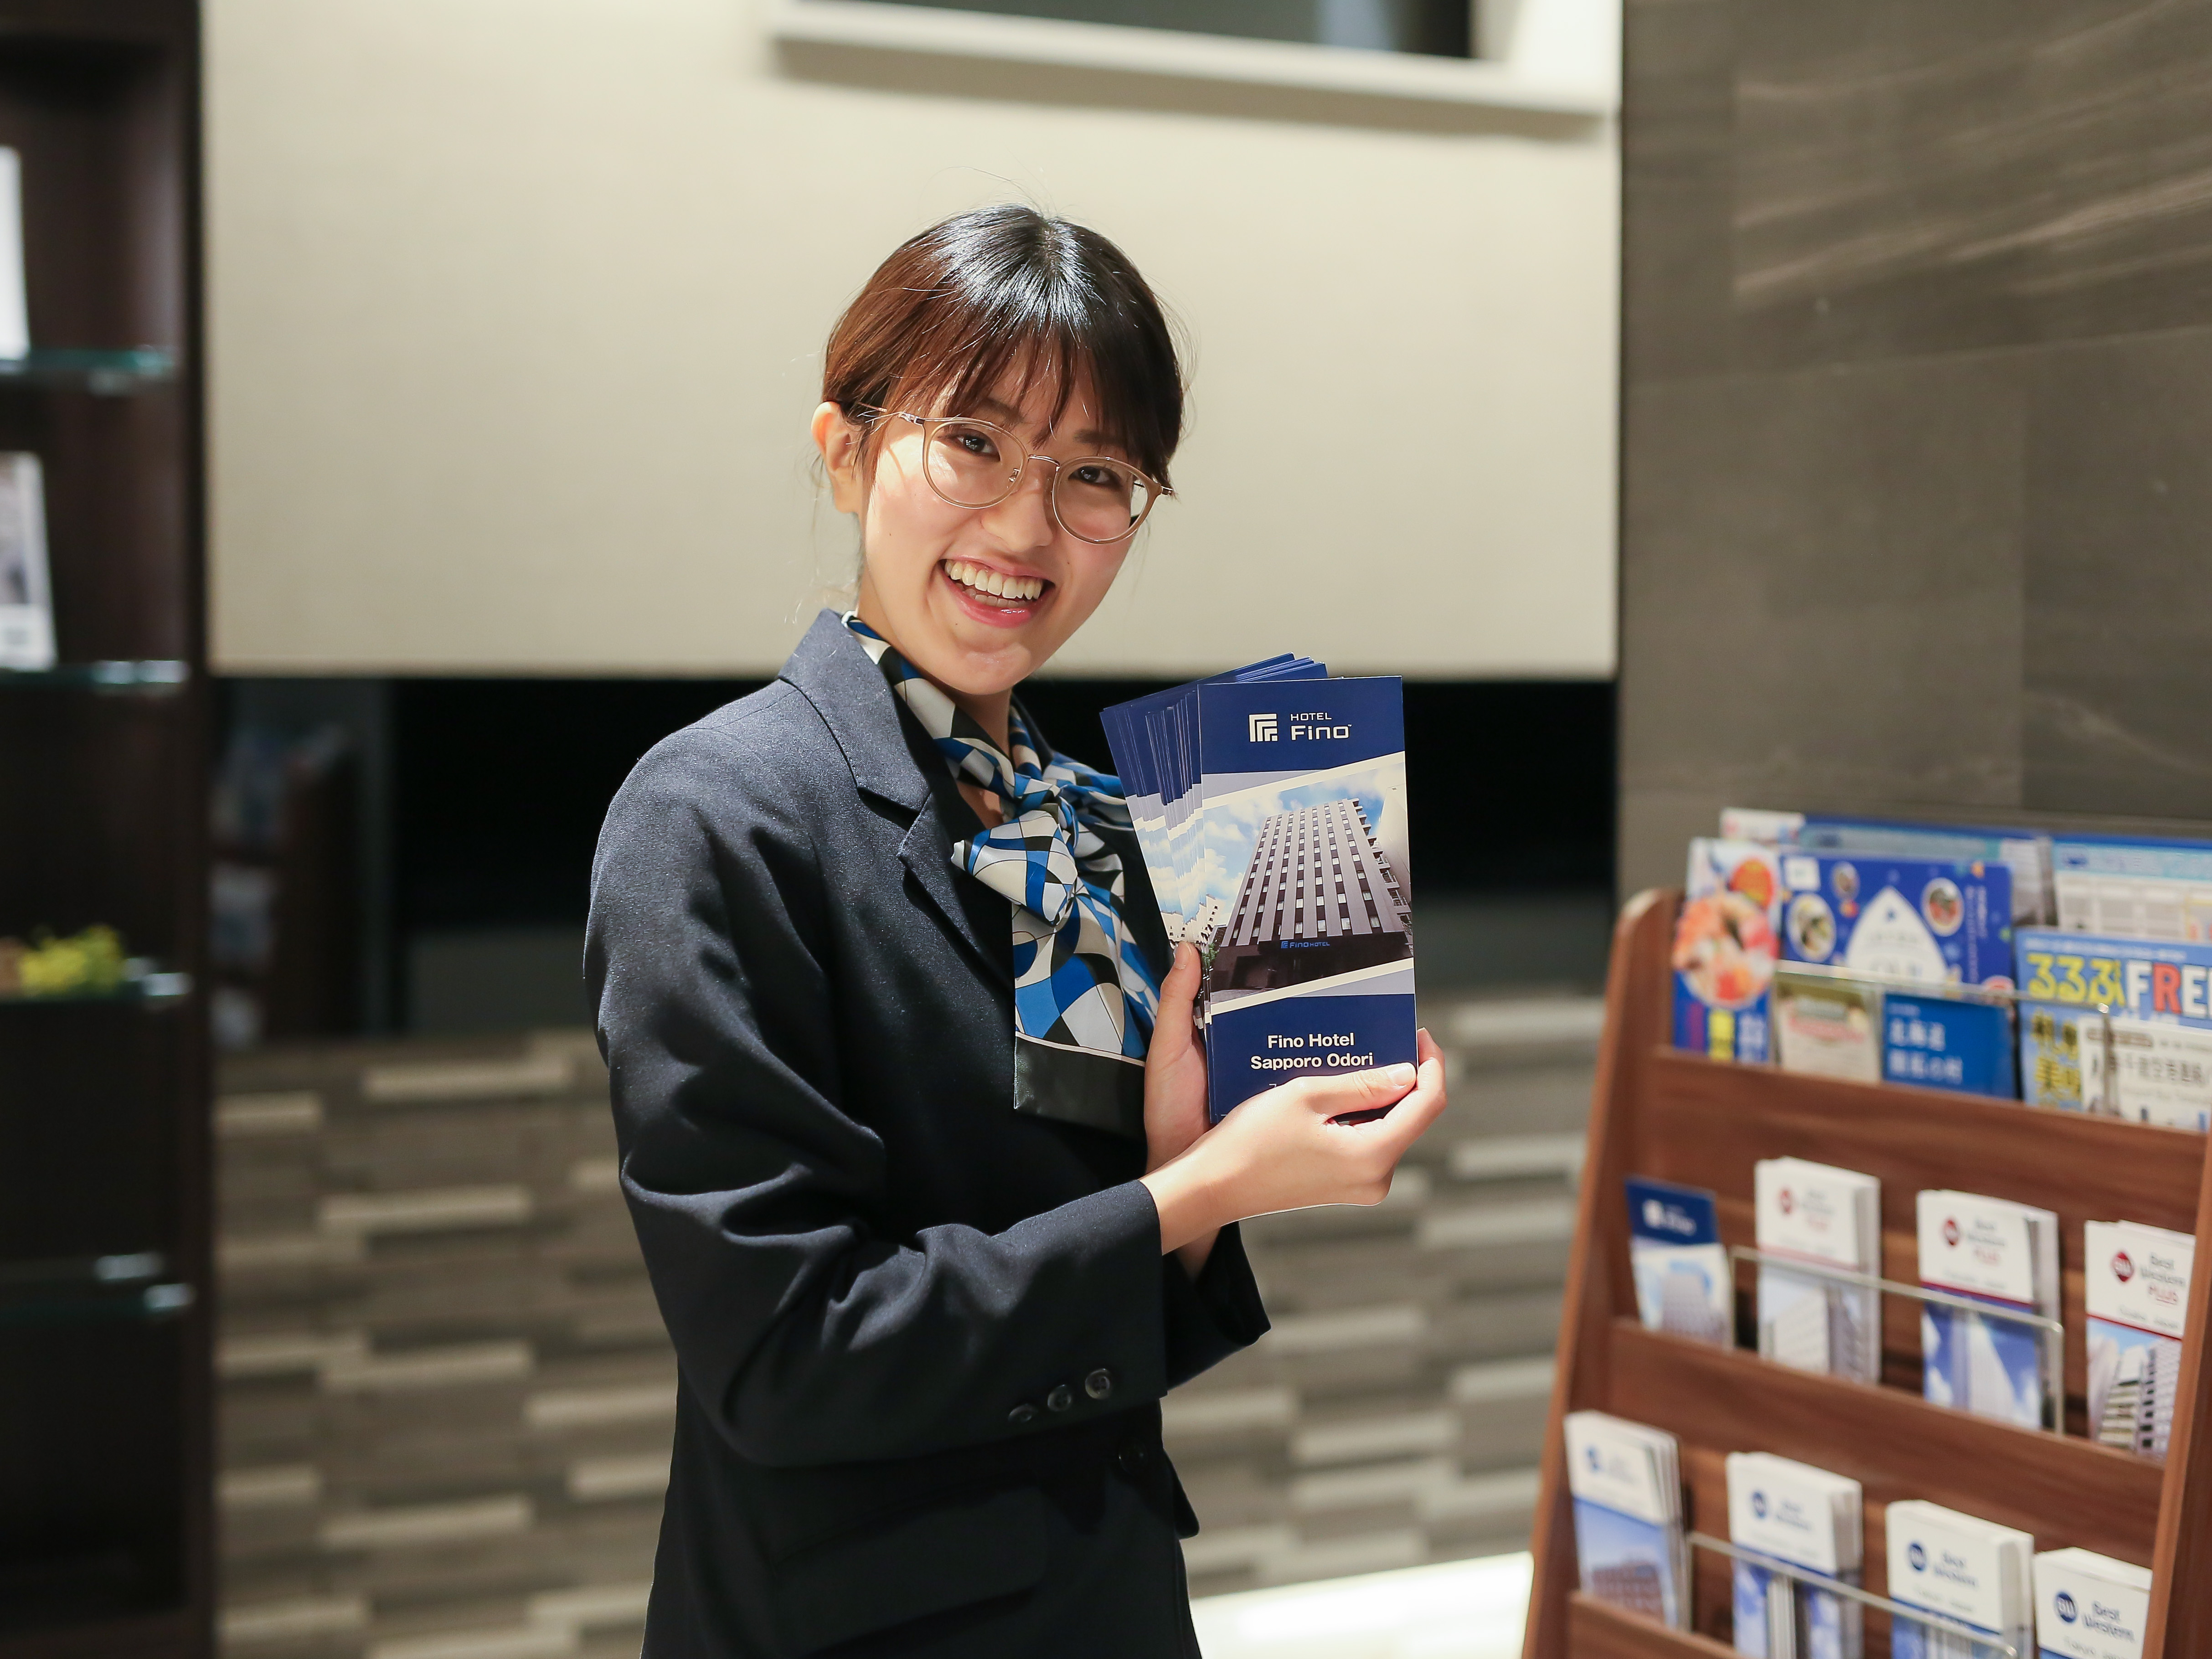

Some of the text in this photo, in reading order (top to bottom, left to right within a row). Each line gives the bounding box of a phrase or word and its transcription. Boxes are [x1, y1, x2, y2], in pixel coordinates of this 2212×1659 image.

[1290, 712, 1332, 721] HOTEL
[1291, 725, 1349, 740] Fino
[1268, 1032, 1354, 1048] Fino Hotel
[1251, 1052, 1373, 1070] Sapporo Odori
[2091, 1600, 2121, 1622] Best
